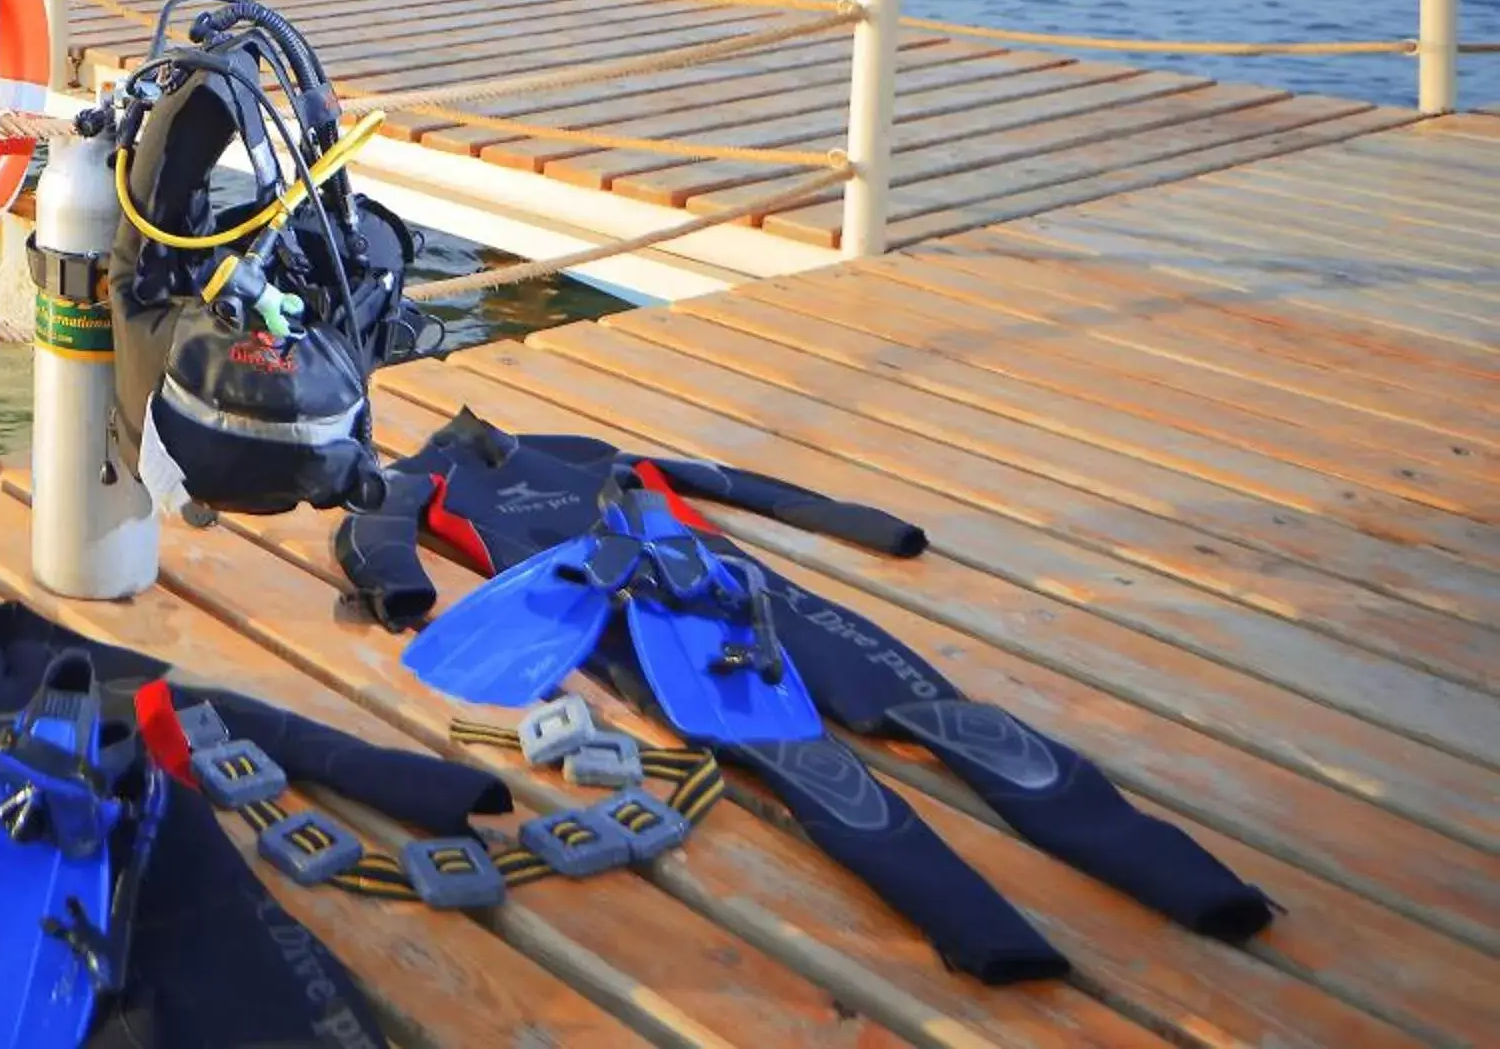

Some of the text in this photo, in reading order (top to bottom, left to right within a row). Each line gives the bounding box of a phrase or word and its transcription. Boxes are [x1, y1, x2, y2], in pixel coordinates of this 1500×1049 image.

[804, 610, 938, 699] Dive pro
[268, 923, 337, 1001] Dive
